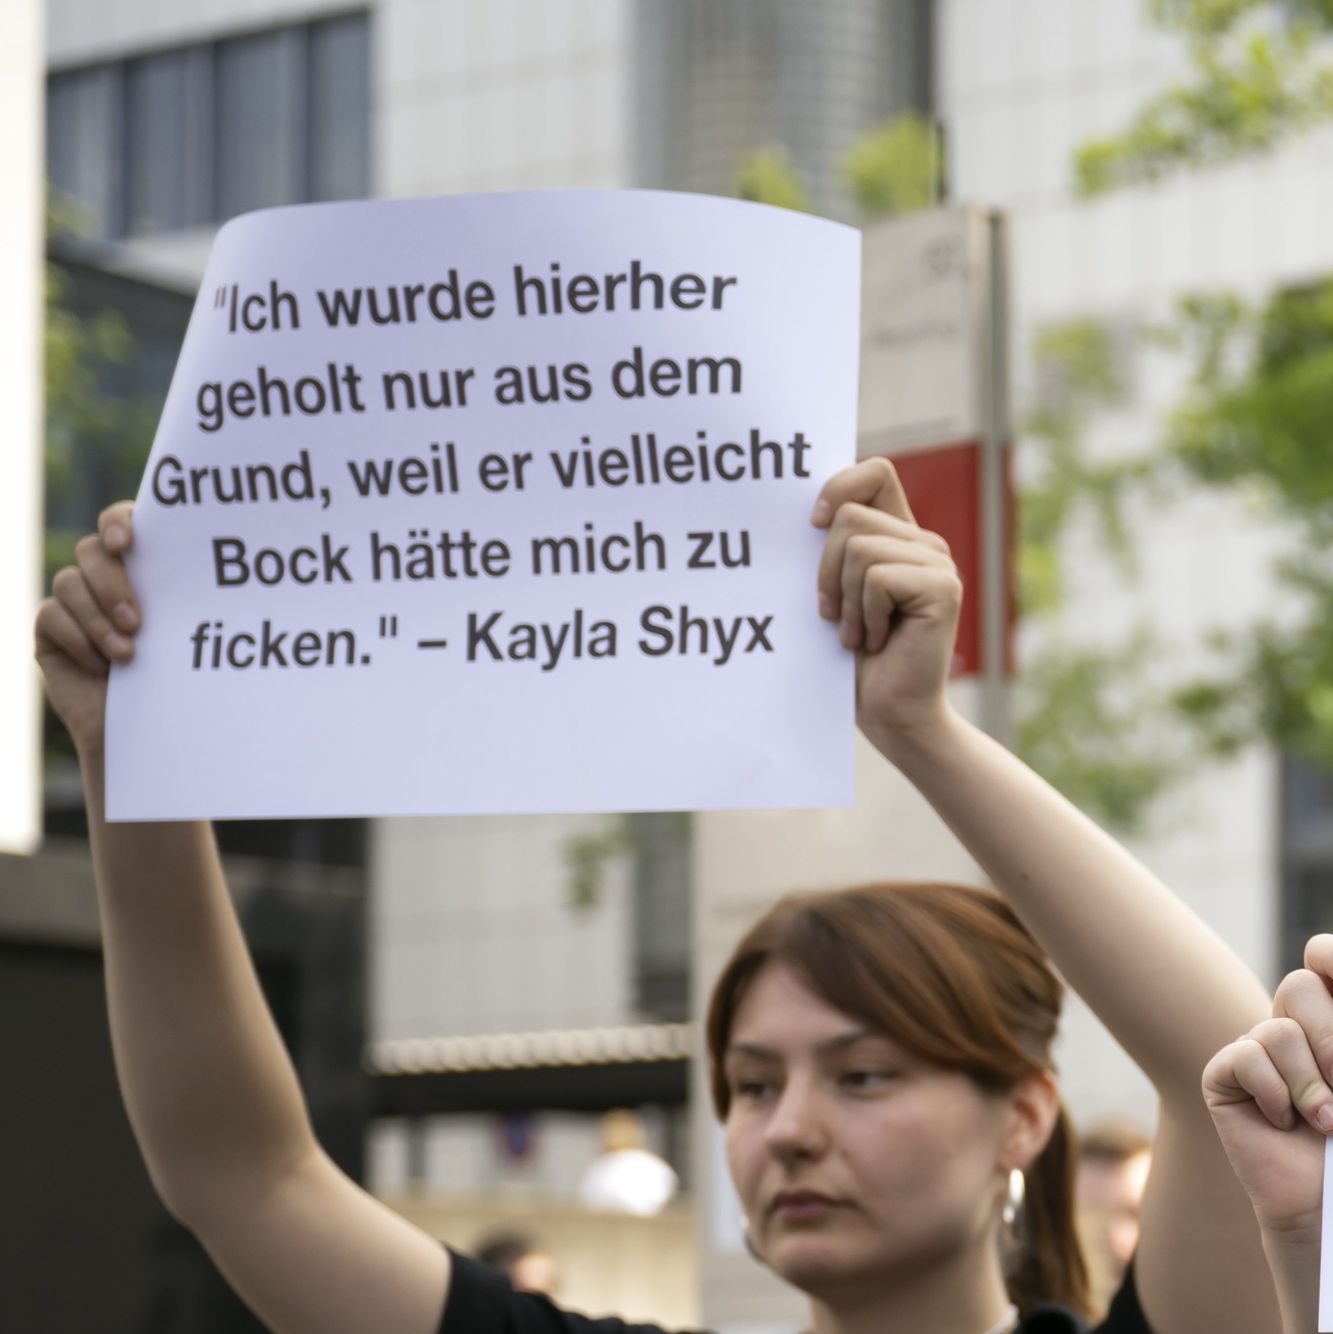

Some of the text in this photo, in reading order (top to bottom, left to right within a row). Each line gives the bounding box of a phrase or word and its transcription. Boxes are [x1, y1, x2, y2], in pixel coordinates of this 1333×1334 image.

[215, 259, 738, 334] "Ich wurde hierher
[197, 346, 742, 434] geholt nur aus dem
[152, 428, 812, 510] Grund, weil er vielleicht
[211, 520, 751, 588] Bock hätte mich zu
[190, 614, 398, 671] ficken."
[466, 608, 617, 673] Kayla
[638, 604, 774, 667] Shyx
